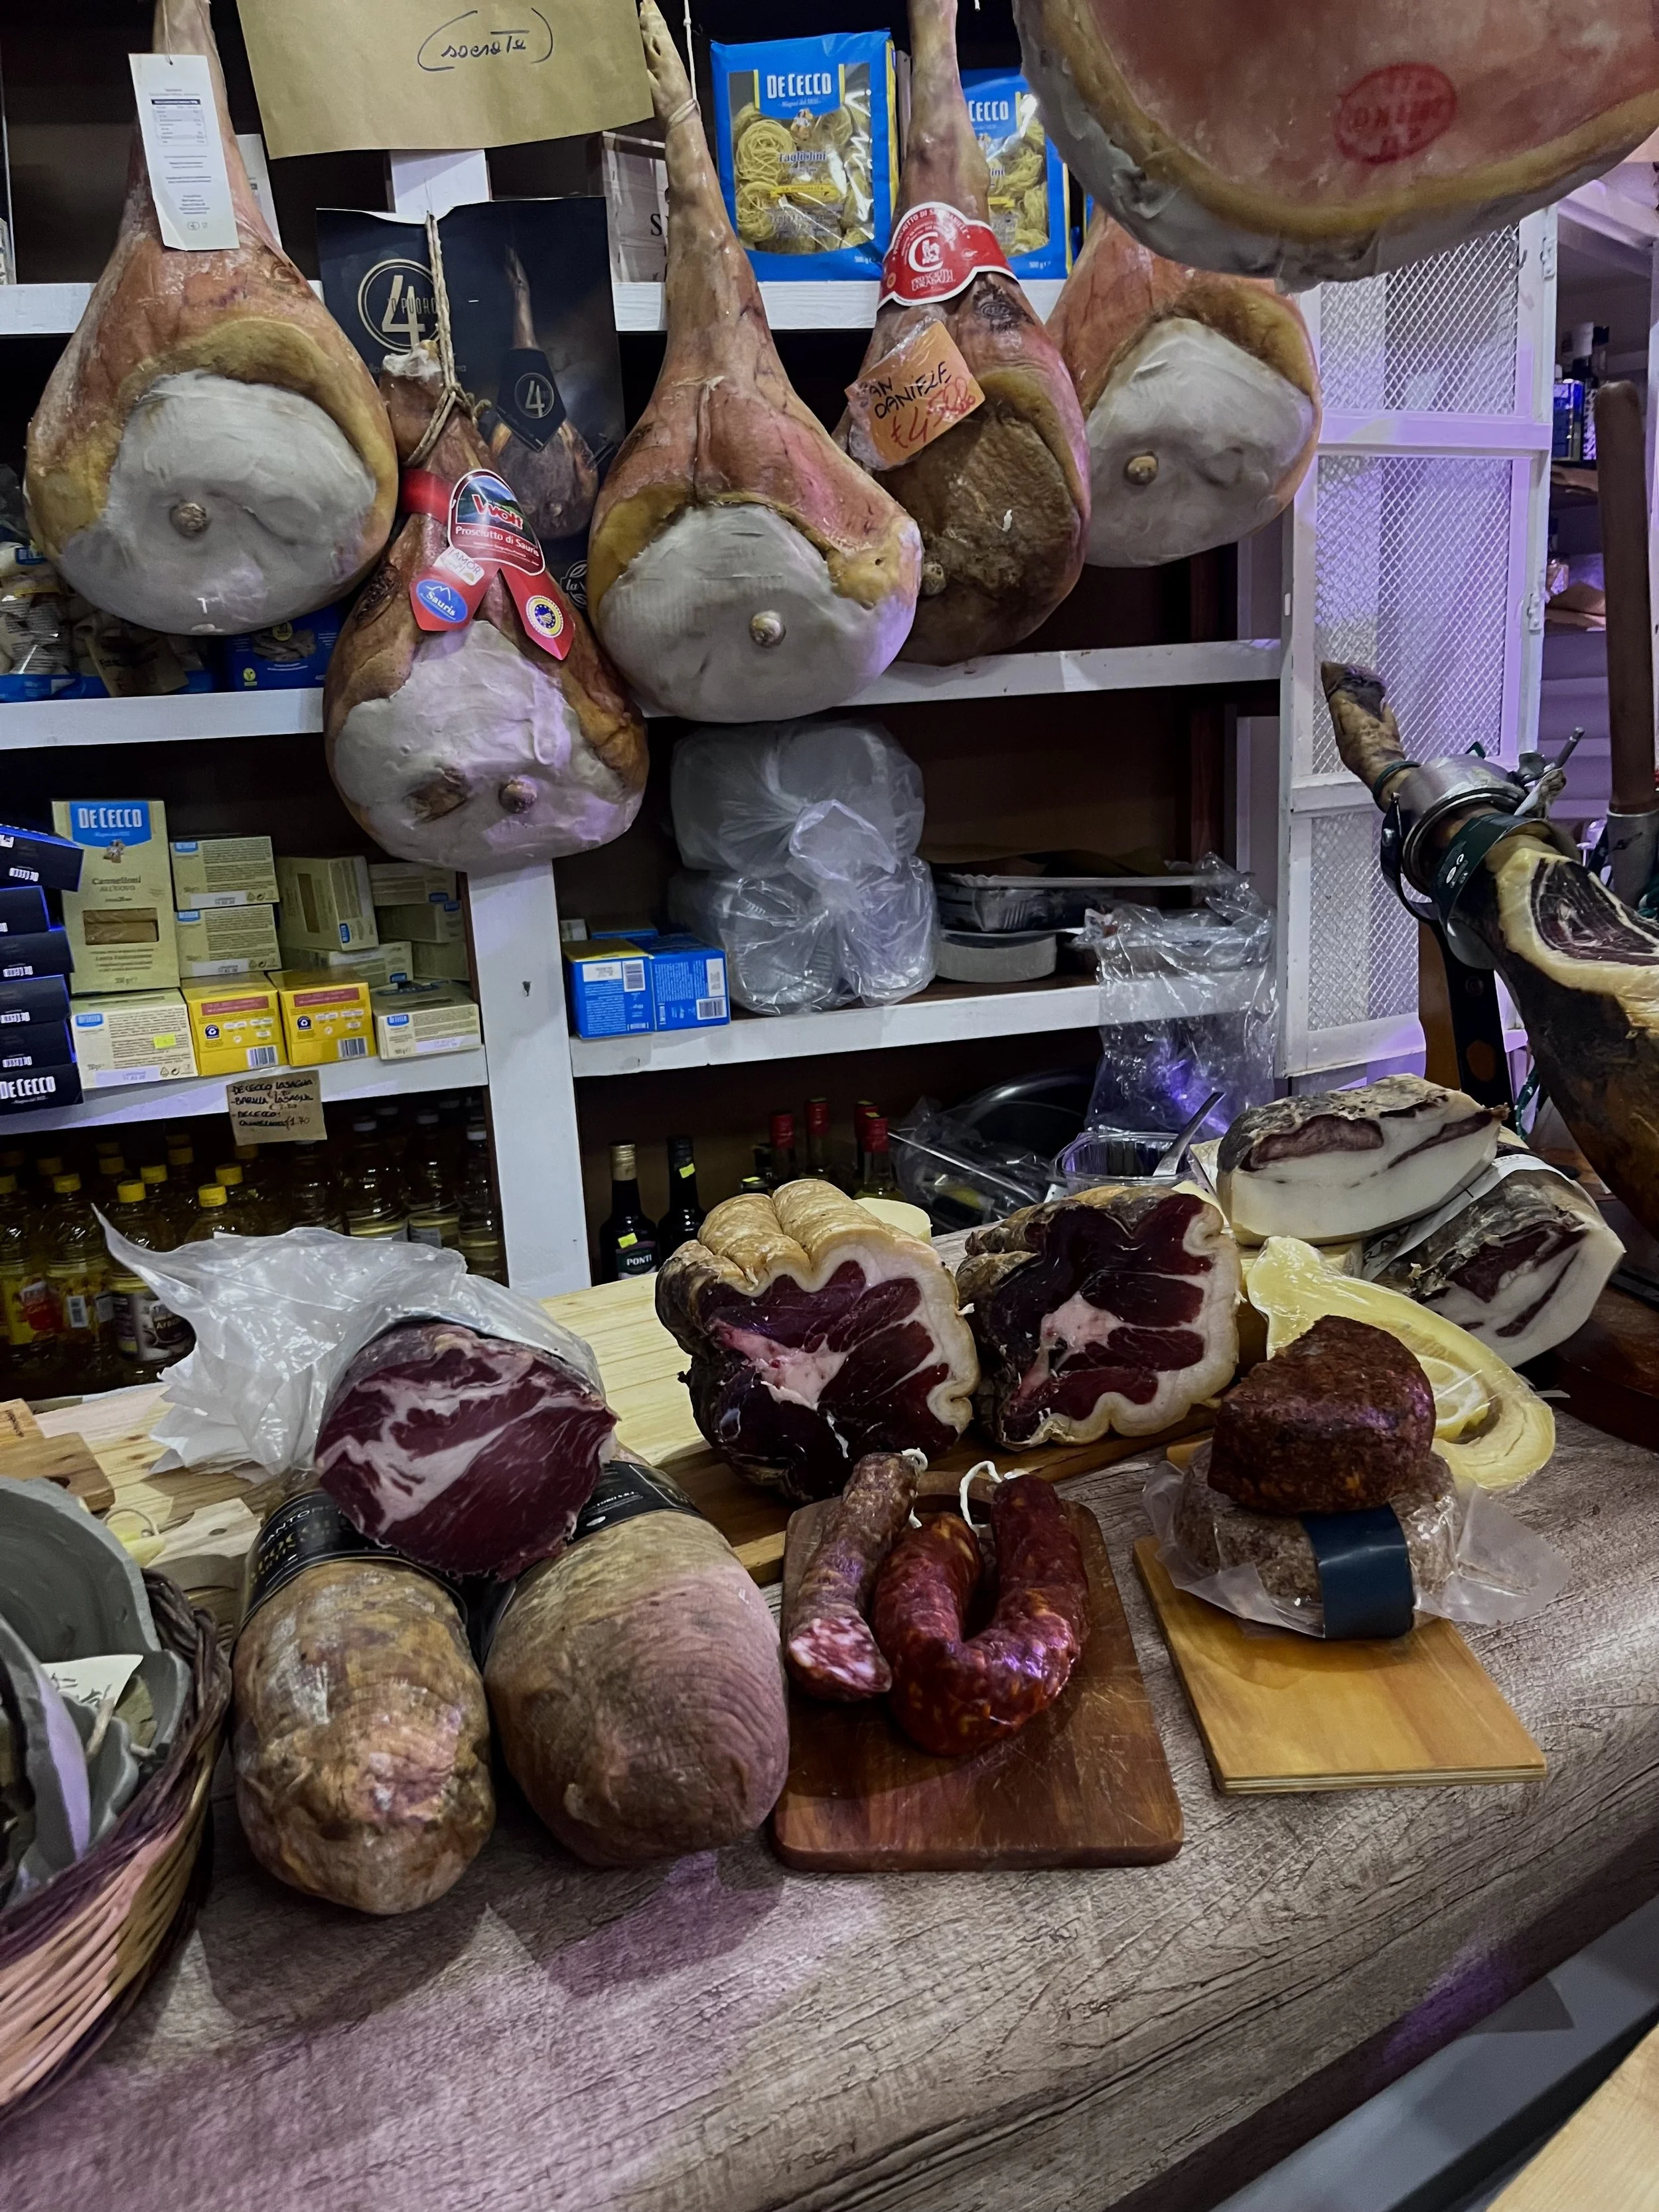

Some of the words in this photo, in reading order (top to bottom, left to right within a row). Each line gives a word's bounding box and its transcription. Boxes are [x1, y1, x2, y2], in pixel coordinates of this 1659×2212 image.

[766, 74, 786, 99] DE
[787, 72, 832, 97] CECCO
[968, 100, 1009, 122] CECCO
[455, 526, 503, 541] Prosciutto
[505, 535, 514, 544] di
[516, 538, 540, 557] Sauris
[426, 591, 456, 617] Sauris
[78, 807, 98, 829] DE
[99, 807, 143, 829] CECCO
[16, 1076, 56, 1097] CECCO
[626, 1254, 652, 1266] PONTI
